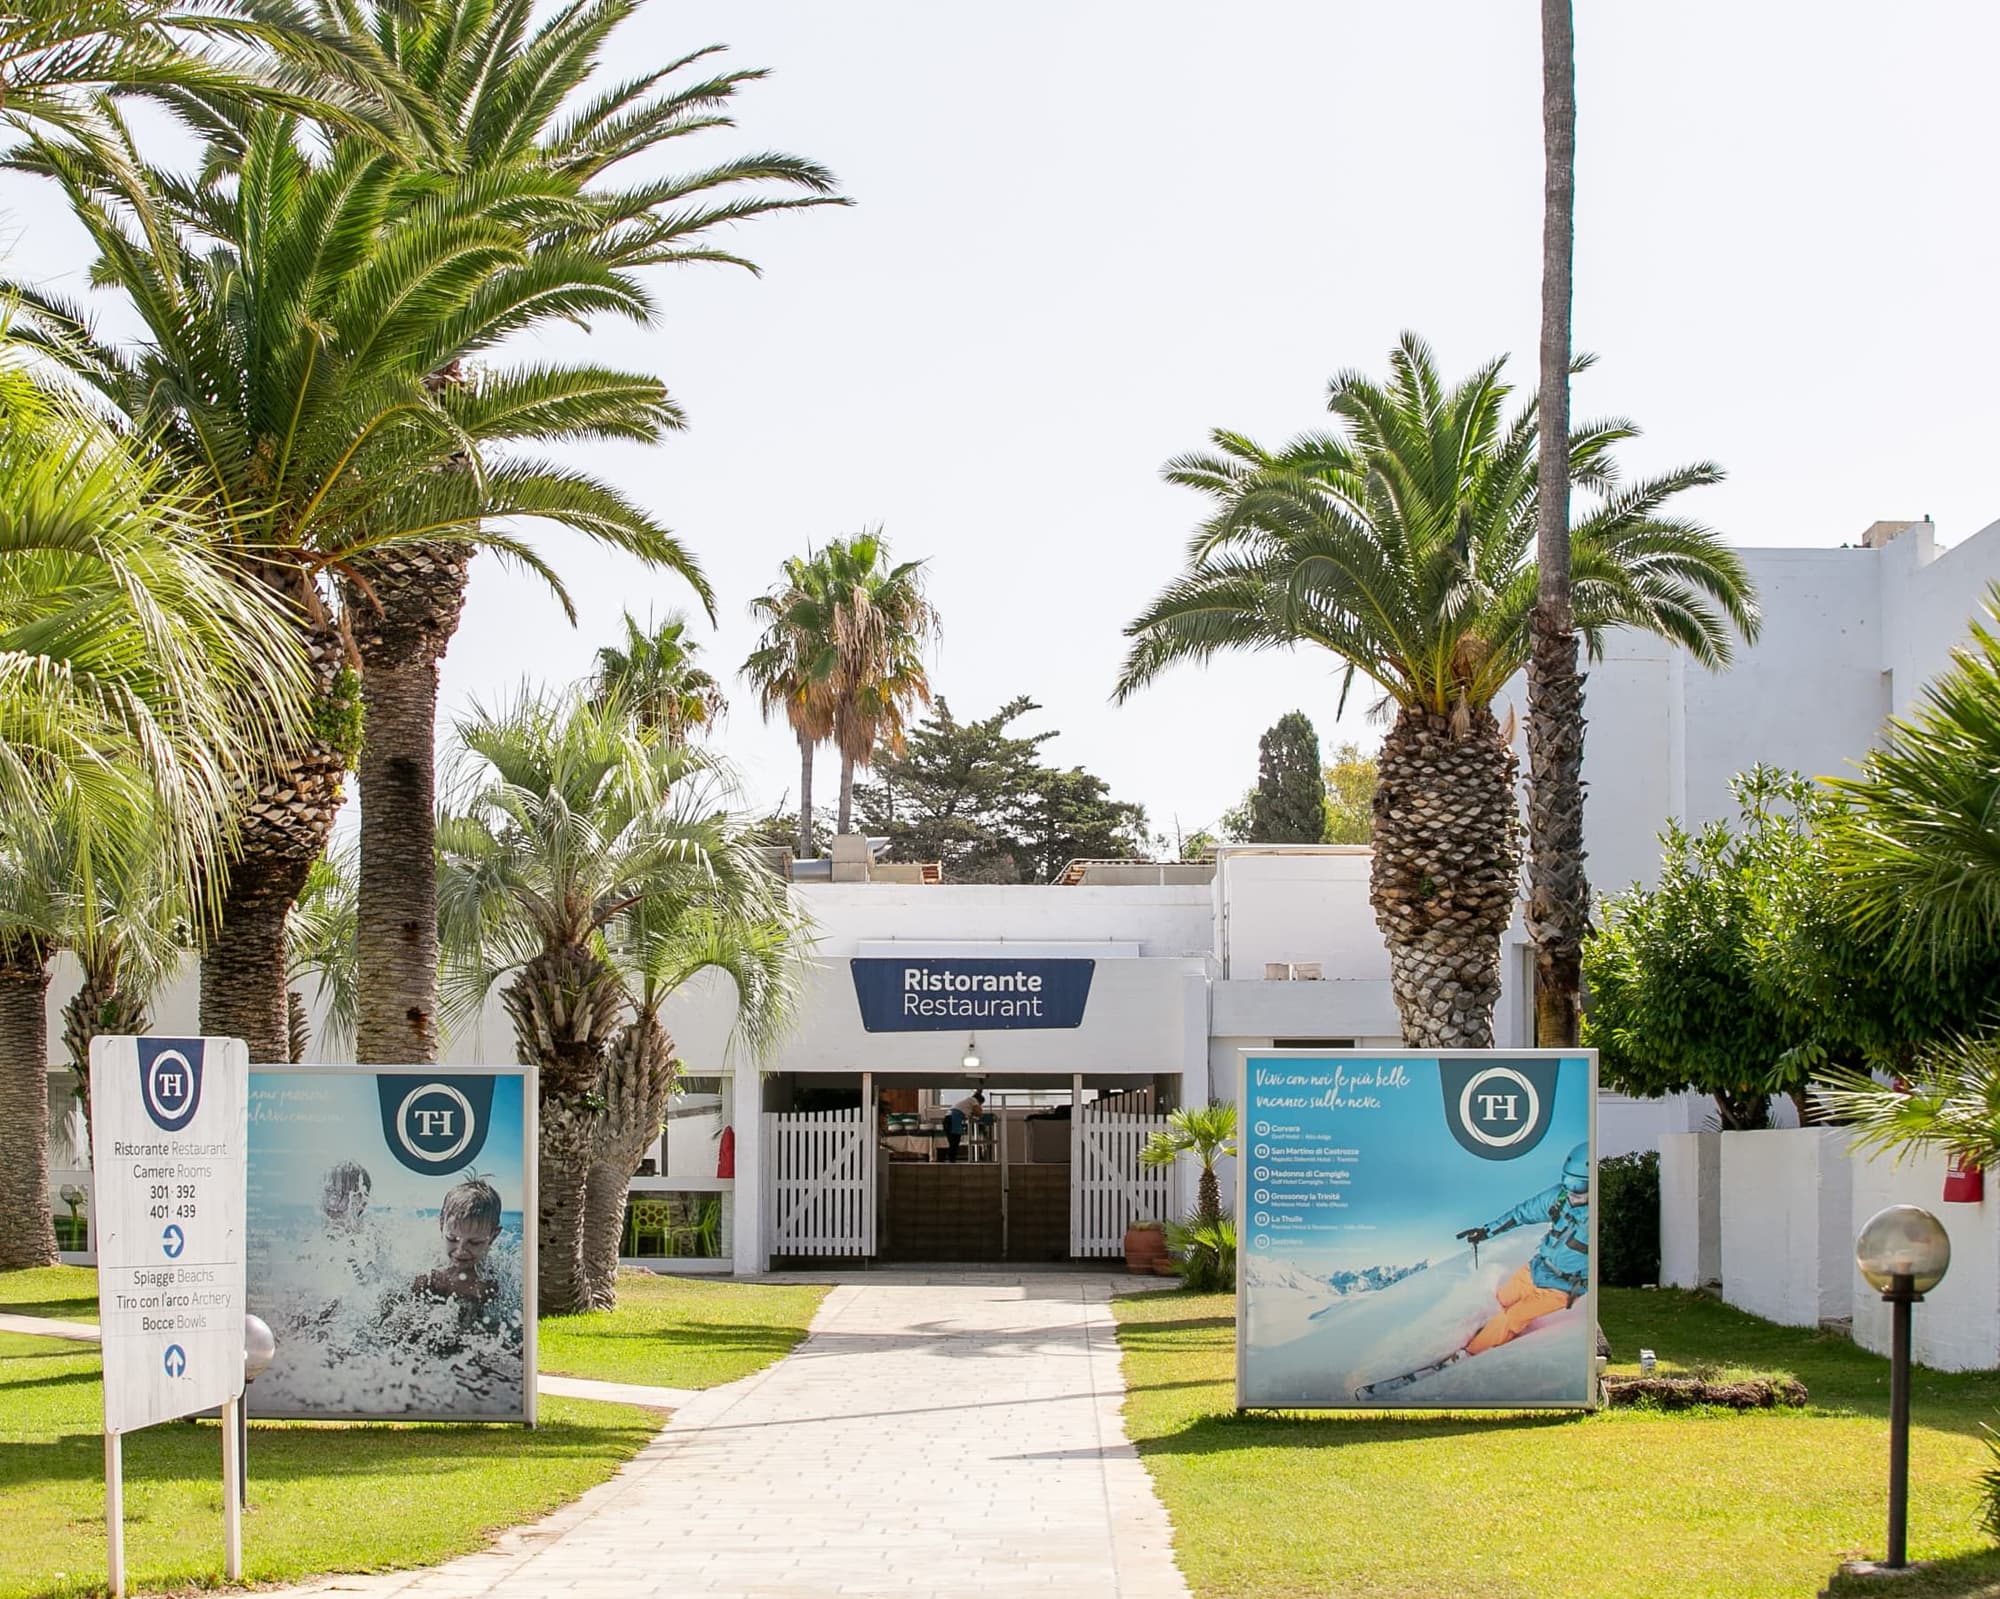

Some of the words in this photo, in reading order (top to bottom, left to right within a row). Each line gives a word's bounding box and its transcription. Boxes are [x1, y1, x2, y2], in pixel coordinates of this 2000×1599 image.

[904, 969, 1042, 991] Ristorante
[904, 993, 1043, 1016] Restaurant
[159, 1073, 183, 1097] TH
[1256, 1068, 1285, 1086] Vivi
[1286, 1075, 1308, 1086] con
[1310, 1073, 1333, 1086] noi
[1334, 1065, 1349, 1089] le
[1350, 1072, 1374, 1093] più
[1375, 1065, 1410, 1088] belle
[1310, 1088, 1346, 1111] sulla
[1477, 1095, 1519, 1121] TH
[414, 1110, 454, 1136] TH
[114, 1142, 169, 1156] Ristorante
[172, 1141, 227, 1155] Restaurant
[133, 1164, 175, 1178] Camere
[177, 1164, 212, 1178] Rooms
[1271, 1170, 1304, 1178] Madonna
[150, 1185, 169, 1199] 301
[176, 1184, 195, 1198] 392
[150, 1205, 169, 1218] 401
[176, 1204, 195, 1218] 439
[134, 1271, 175, 1287] Spiagge
[177, 1268, 214, 1283] Beachs
[116, 1295, 137, 1309] Tiro
[140, 1297, 159, 1308] con
[161, 1292, 190, 1307] l'arco
[192, 1291, 231, 1308] Archery
[142, 1316, 174, 1331] Bocce
[177, 1314, 207, 1329] Bowls
